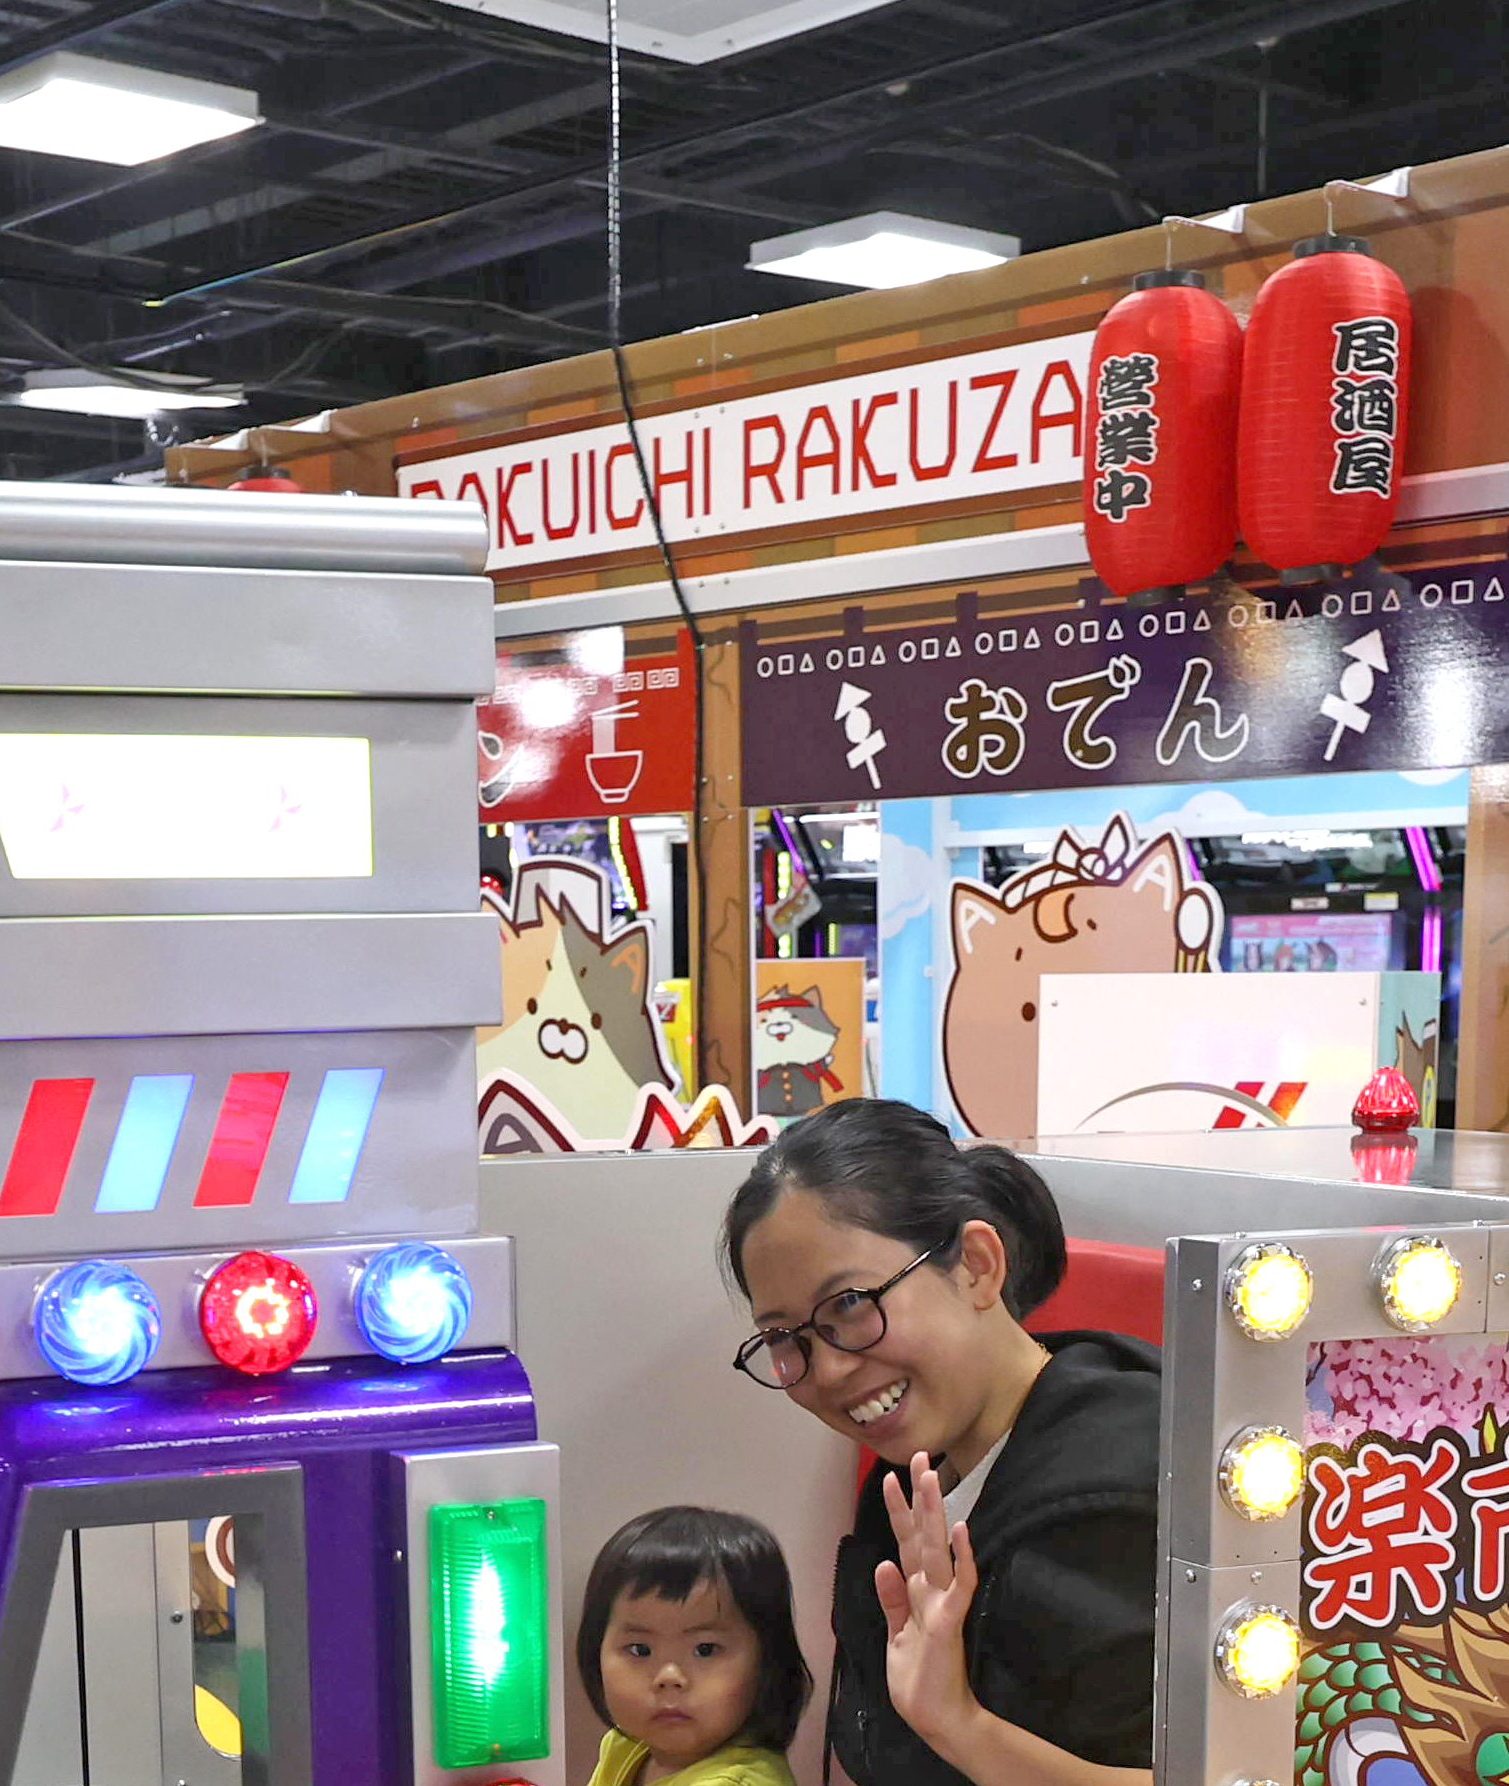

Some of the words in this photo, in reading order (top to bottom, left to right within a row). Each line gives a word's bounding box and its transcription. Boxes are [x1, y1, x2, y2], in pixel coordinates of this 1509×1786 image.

[410, 428, 713, 549] KUICHI
[742, 361, 1086, 509] RAKUZA
[1093, 353, 1160, 522] 営業中
[1329, 316, 1400, 498] 居酒屋
[941, 654, 1249, 779] おでん
